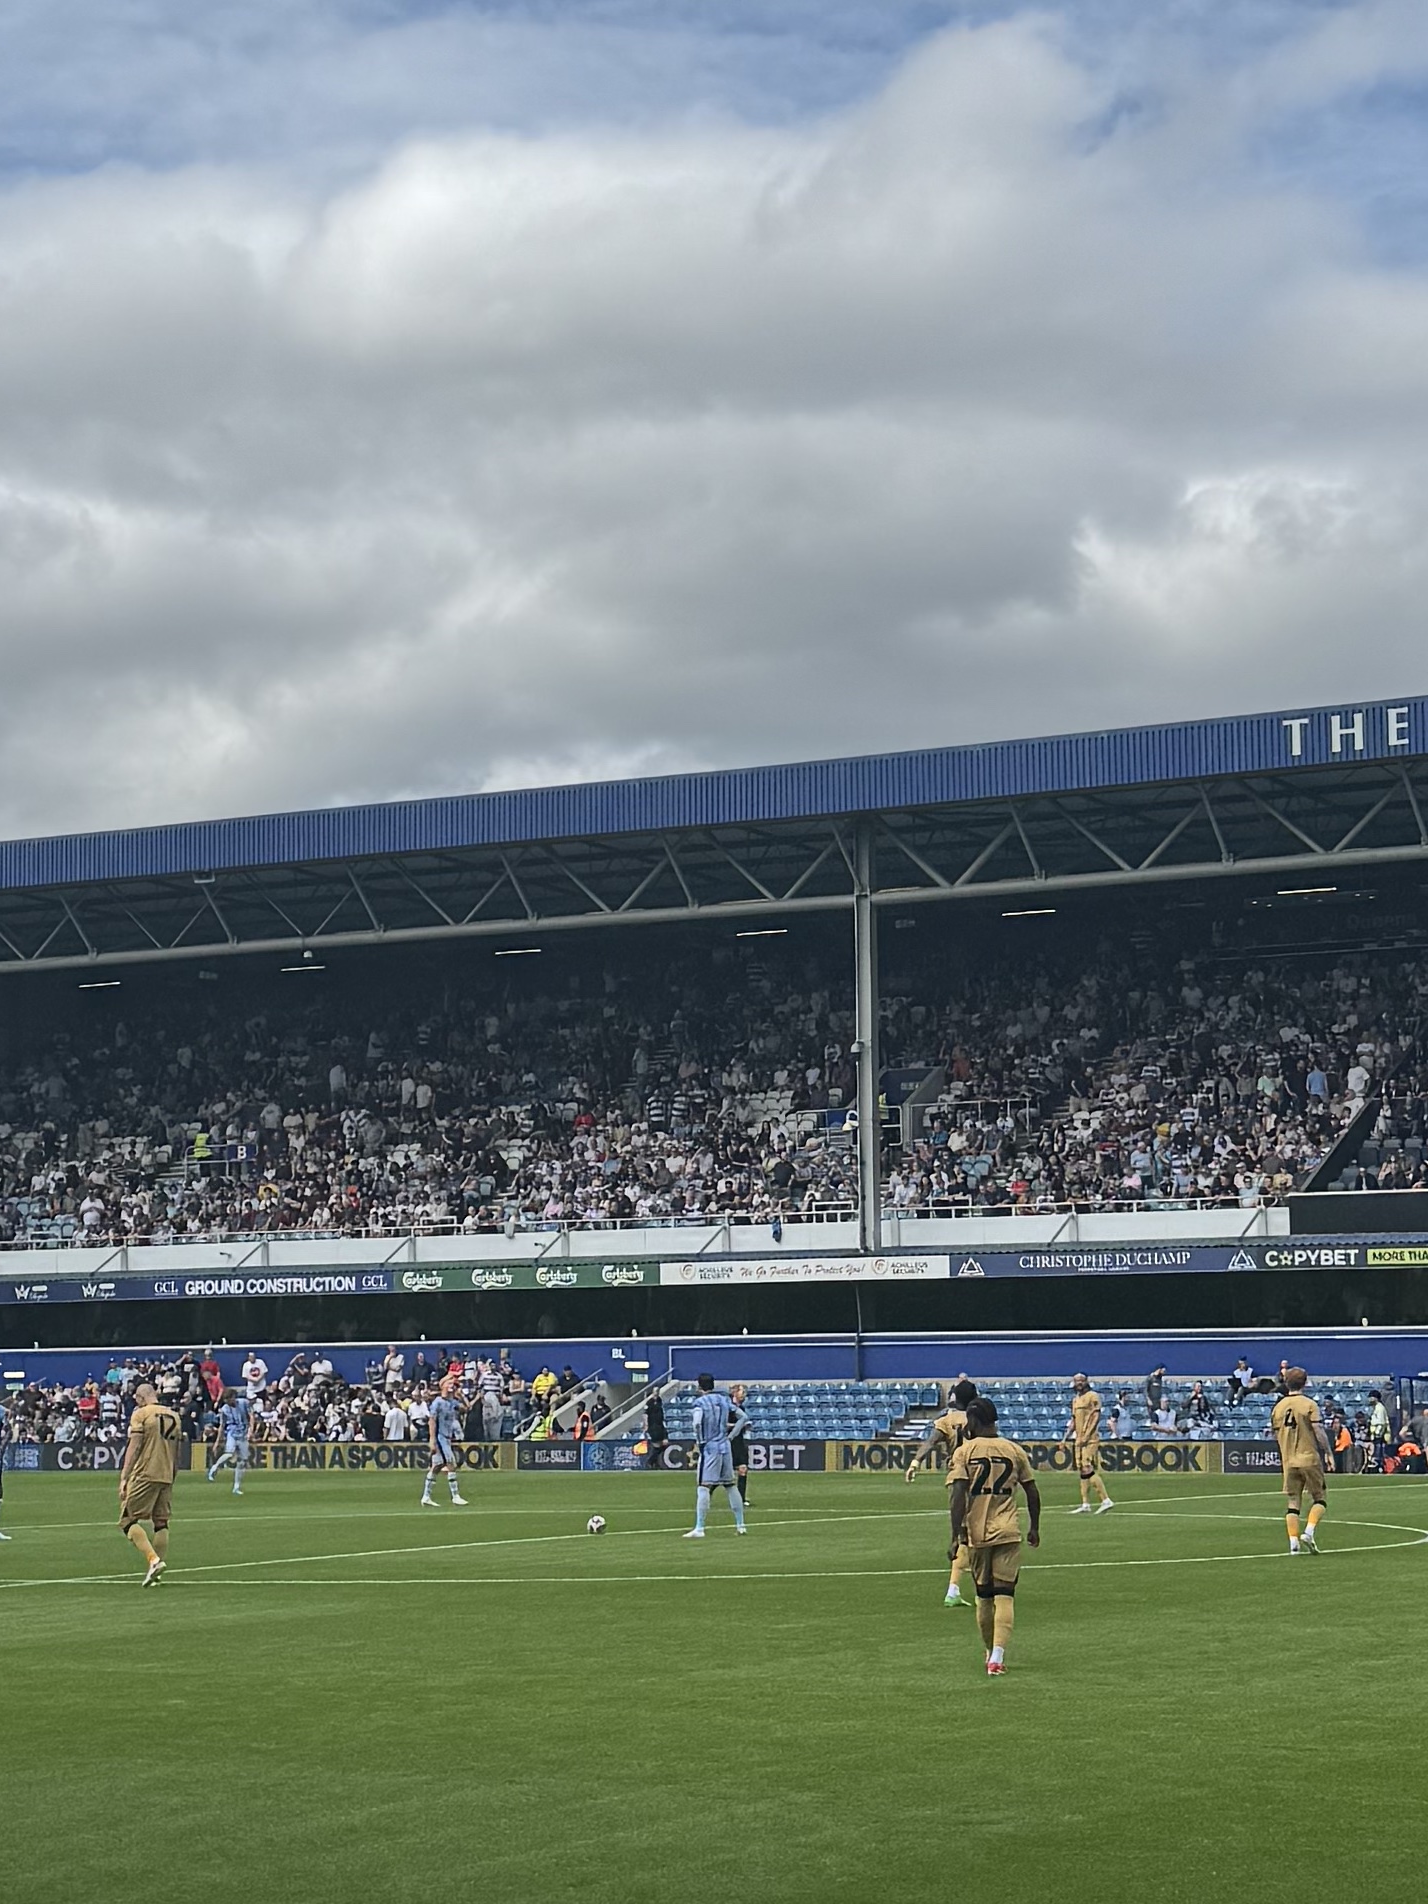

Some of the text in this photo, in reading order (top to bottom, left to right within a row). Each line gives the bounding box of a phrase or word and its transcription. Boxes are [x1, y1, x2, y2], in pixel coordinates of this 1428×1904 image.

[1282, 705, 1410, 757] THE
[237, 1145, 247, 1159] B
[1018, 1250, 1191, 1269] CHRISTOPHE DUCHAMP
[1372, 1251, 1405, 1262] MORE
[184, 1275, 357, 1296] GROUND CONSTRUCTION
[402, 1270, 443, 1293] Carlsberg
[471, 1267, 514, 1290] Carlsberg
[535, 1266, 578, 1289] Carlsberg
[602, 1264, 644, 1286] Carlsberg
[611, 1347, 626, 1359] BL
[154, 1413, 177, 1440] 12
[1284, 1408, 1297, 1429] 4
[270, 1445, 325, 1470] THAN
[329, 1445, 345, 1470] A
[347, 1444, 500, 1470] SPORTSOOK
[967, 1456, 1013, 1497] 22
